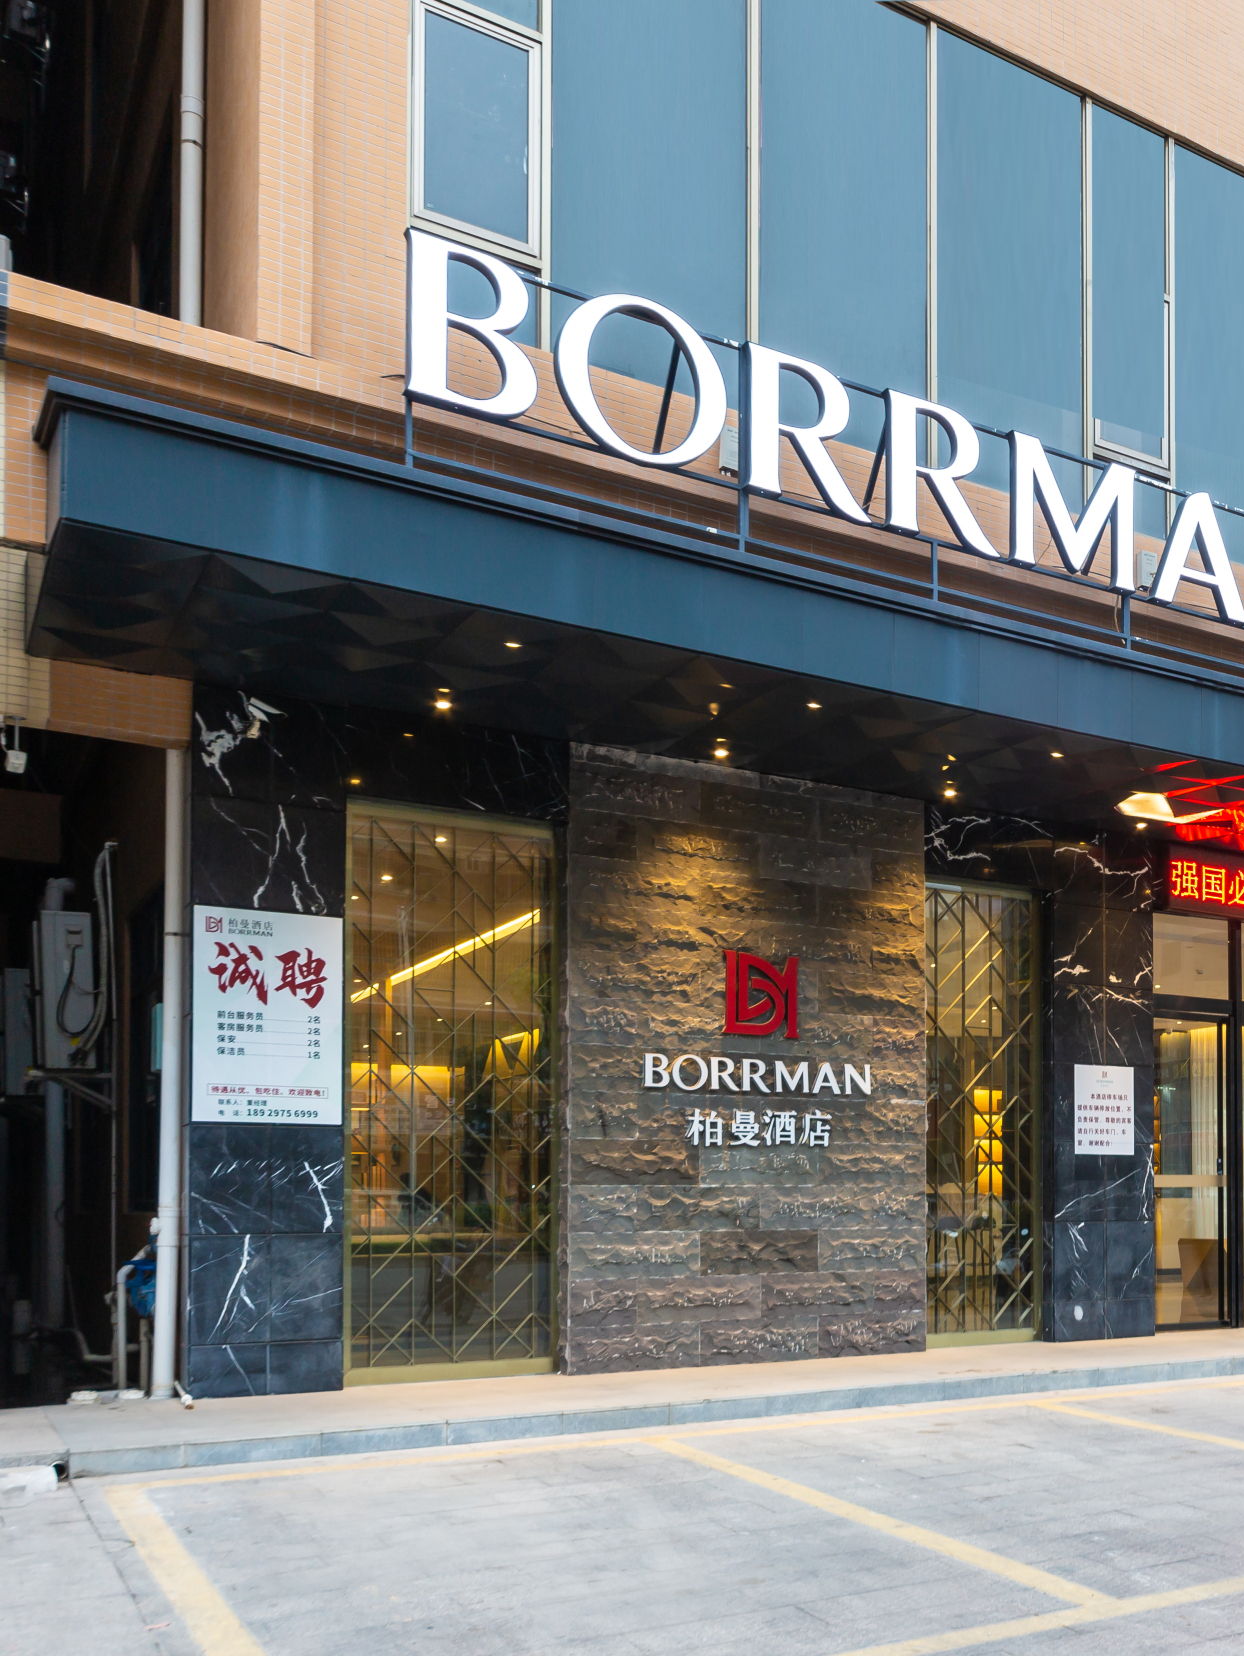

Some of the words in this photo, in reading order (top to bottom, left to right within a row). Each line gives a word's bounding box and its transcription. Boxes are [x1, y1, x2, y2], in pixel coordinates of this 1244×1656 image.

[228, 918, 274, 931] 柏曼酒店
[228, 928, 274, 937] BORRMAN
[208, 941, 328, 1009] 诚聘
[217, 1010, 264, 1021] 前台服务员
[307, 1015, 321, 1025] 2名
[217, 1022, 264, 1033] 客房服务员
[307, 1027, 321, 1036] 2名
[217, 1034, 236, 1044] 保安
[307, 1039, 321, 1048] 2名
[217, 1046, 245, 1056] 保洁员
[307, 1051, 321, 1060] 1名
[643, 1052, 872, 1096] BORRMAN
[246, 1108, 266, 1118] 189
[267, 1109, 292, 1118] 2975
[294, 1110, 319, 1119] 6999
[686, 1108, 833, 1148] 柏曼酒店
